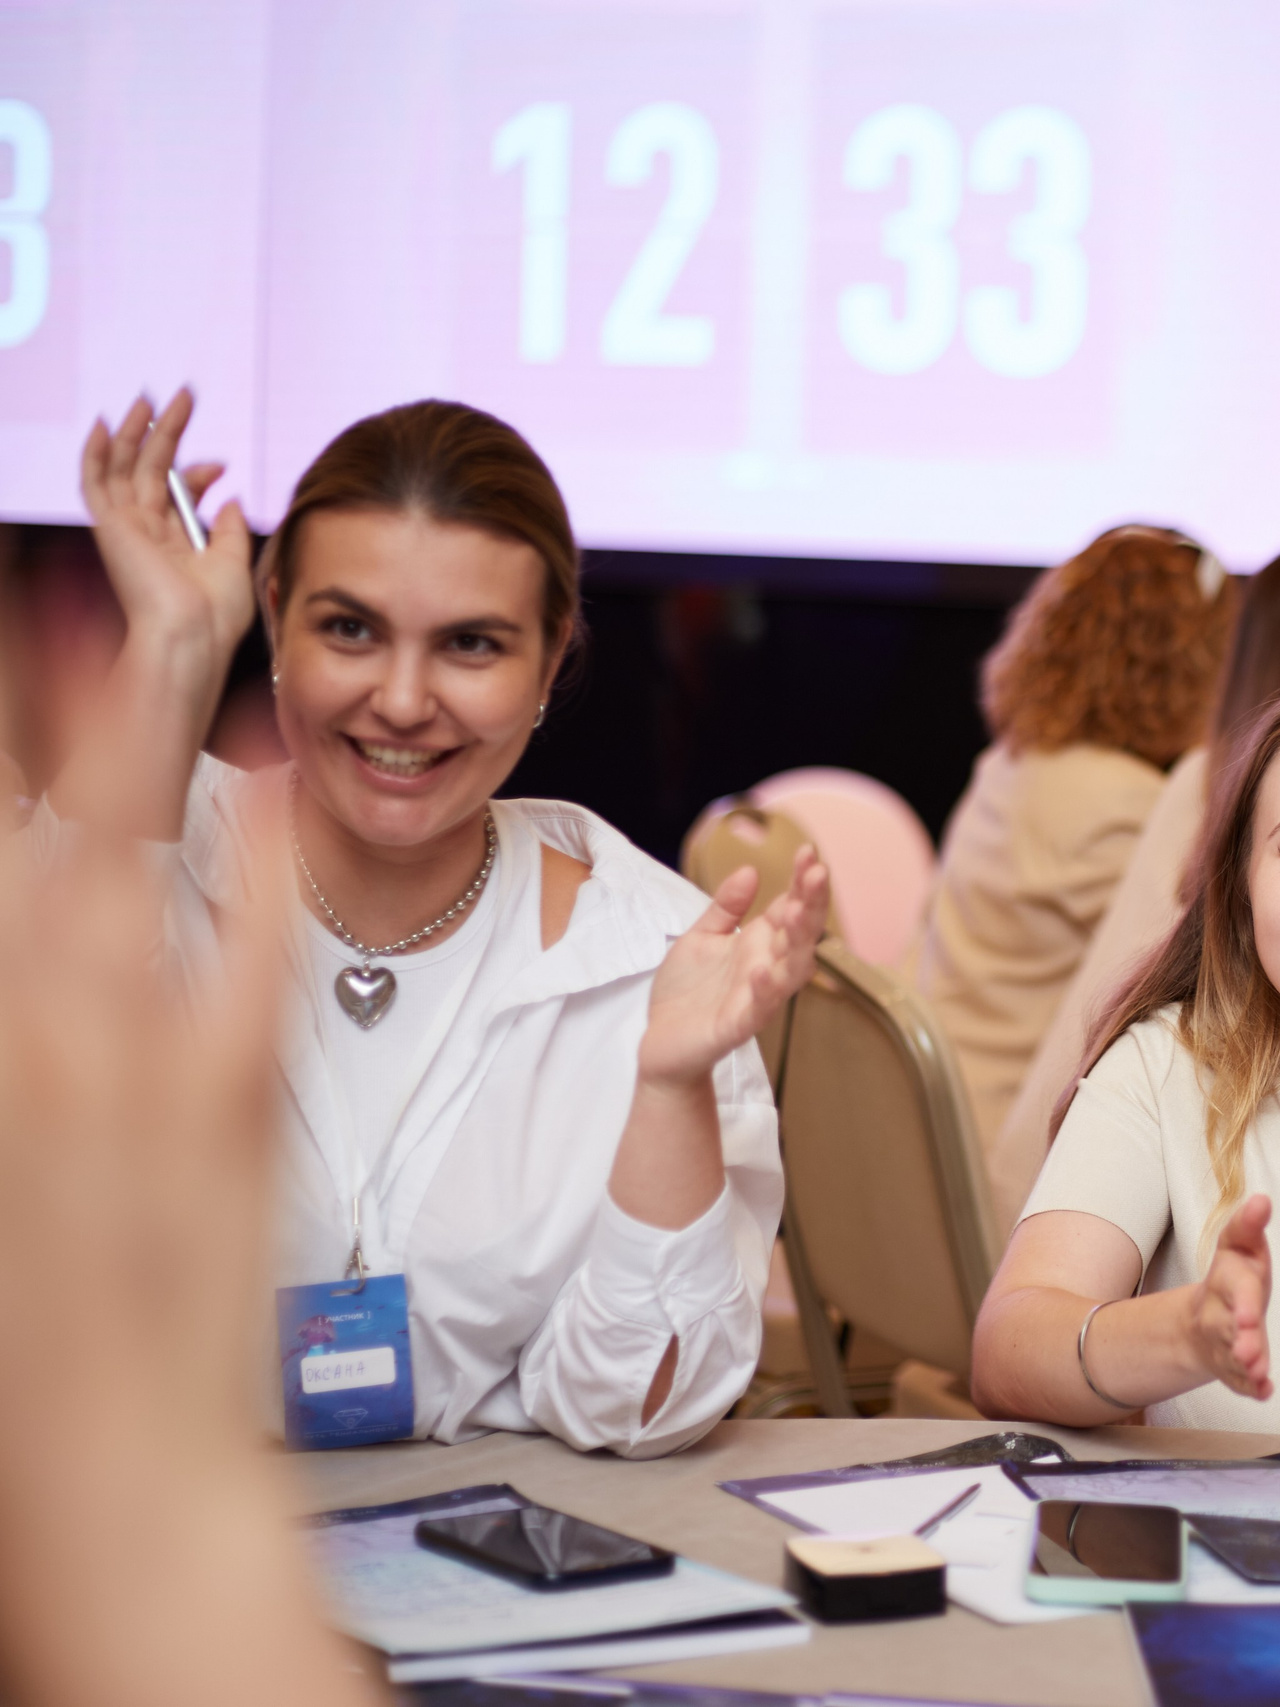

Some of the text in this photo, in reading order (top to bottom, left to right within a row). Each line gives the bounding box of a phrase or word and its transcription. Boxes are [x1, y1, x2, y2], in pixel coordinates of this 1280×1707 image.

[489, 100, 1093, 378] 12 33
[325, 1312, 365, 1324] УЧАСТНИК
